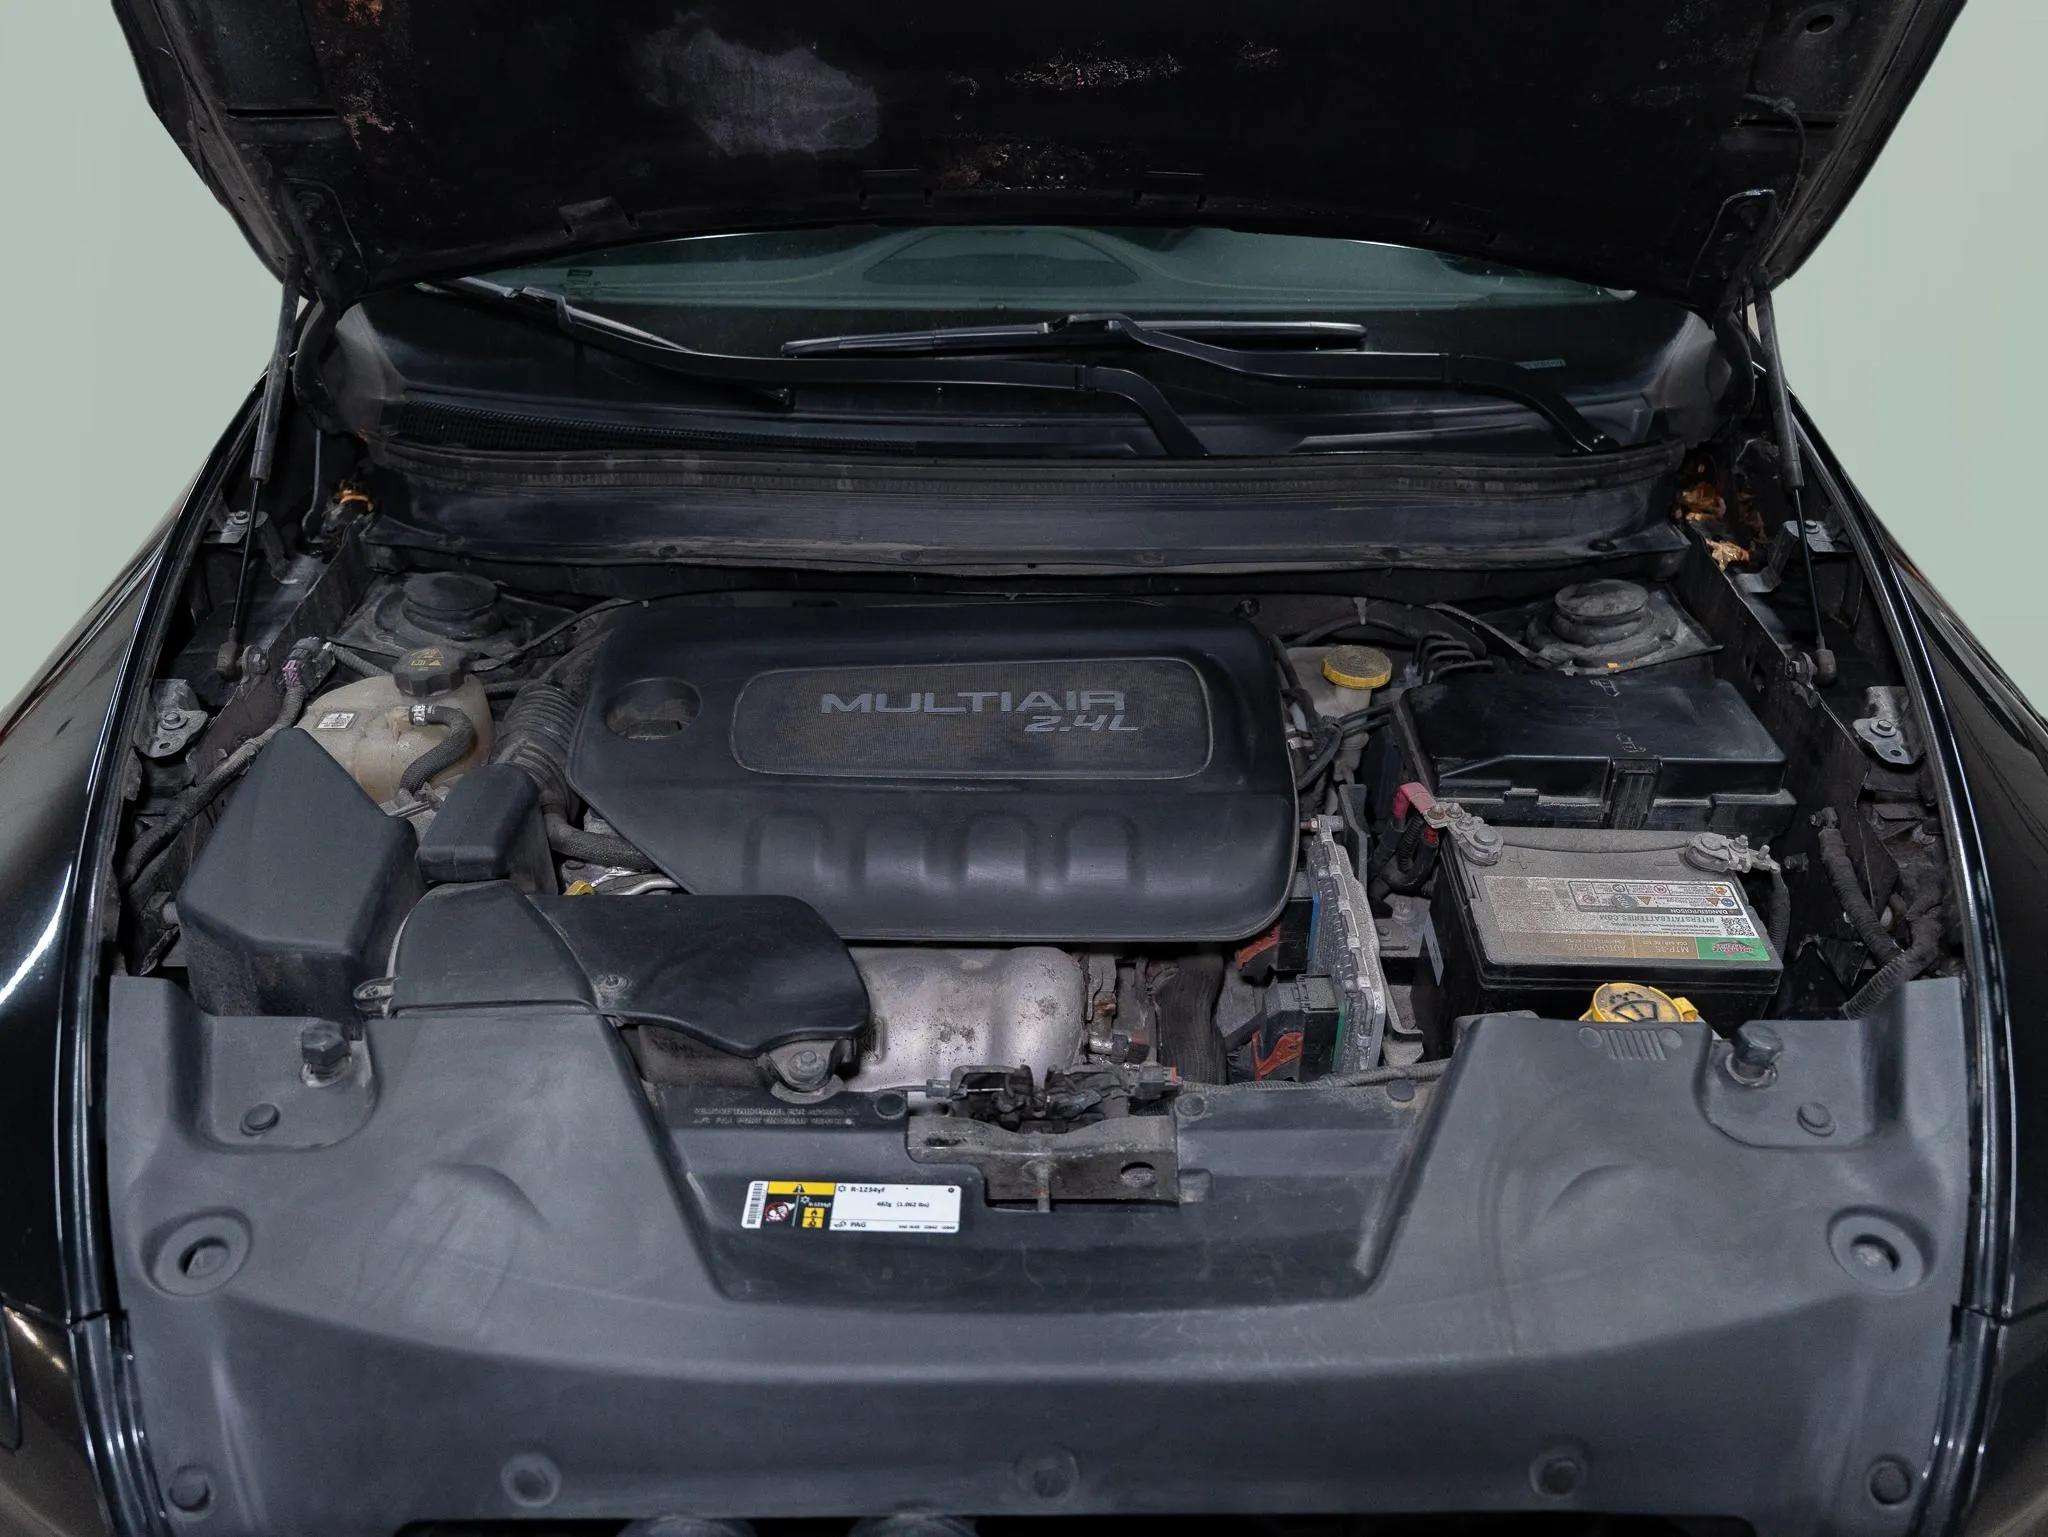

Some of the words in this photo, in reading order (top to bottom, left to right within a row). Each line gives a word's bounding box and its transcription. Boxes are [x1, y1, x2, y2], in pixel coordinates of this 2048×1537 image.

[820, 690, 1126, 714] MULTIAIR
[1024, 714, 1141, 732] 2.4L
[850, 1186, 885, 1194] R-1234yf
